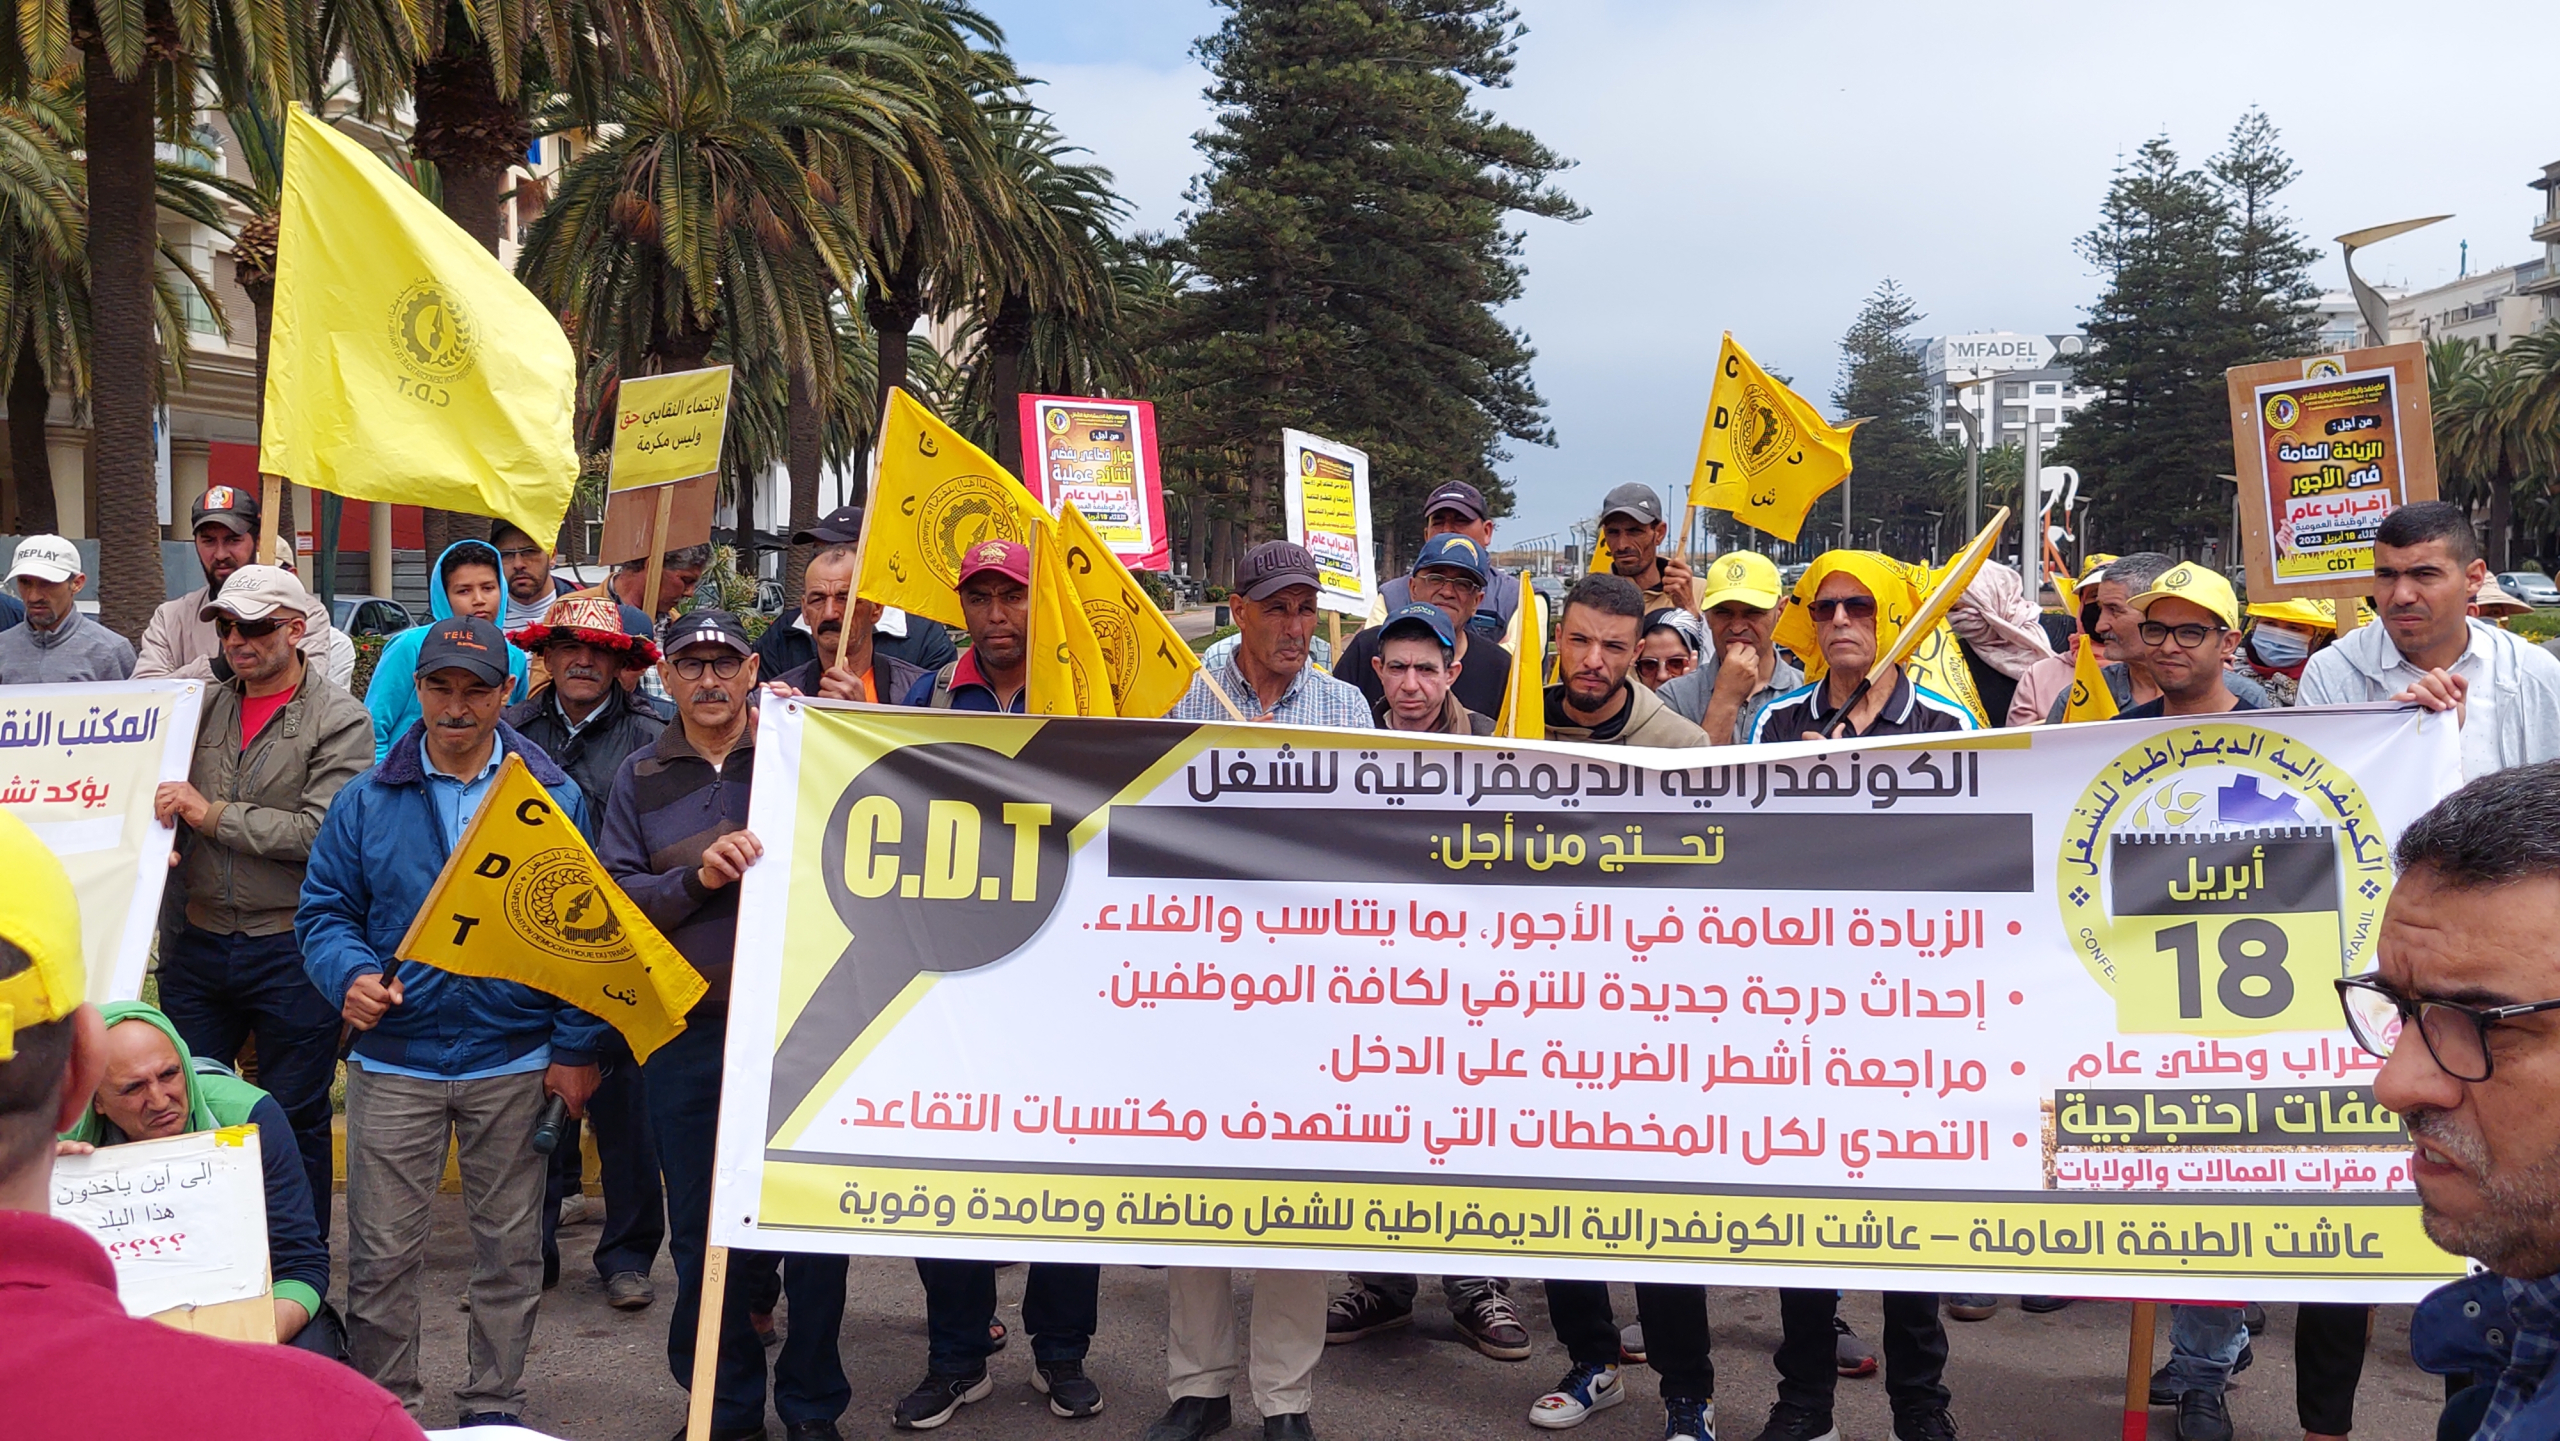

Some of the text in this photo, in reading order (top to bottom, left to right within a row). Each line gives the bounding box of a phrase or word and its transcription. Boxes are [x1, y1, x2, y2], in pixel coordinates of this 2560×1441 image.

[1958, 342, 2038, 357] MFADEL
[620, 410, 640, 430] حق
[642, 399, 684, 428] النقابي
[2359, 418, 2373, 428] من
[637, 425, 702, 454] وليس مكرمة
[2279, 442, 2382, 461] الزيادة العامة
[1079, 449, 1111, 461] قطاعي
[1112, 446, 1134, 465] حوار
[1052, 464, 1132, 486] لنتائج عملية
[2292, 464, 2380, 495] في الأجور
[1063, 489, 1129, 508] إضراب عام
[2291, 494, 2388, 523] إضراب عام
[2296, 520, 2332, 532] العمومية
[2334, 516, 2367, 527] الوظيفة
[2344, 532, 2356, 541] 18
[2298, 535, 2322, 545] 2023
[2323, 531, 2344, 545] أبريل
[18, 549, 60, 563] REPLAY
[1254, 547, 1310, 576] POLICE
[2327, 558, 2356, 571] CDT
[1328, 577, 1341, 588] CDT
[443, 631, 474, 640] TELE
[0, 706, 160, 758] المكتب النق
[1187, 743, 1978, 809] الكونفدرالية الديمقراطية للشغل
[0, 775, 110, 809] يؤكد تش
[1430, 813, 1514, 870] أجل:
[2066, 779, 2122, 876] للشغل
[844, 794, 1052, 902] C.D.T
[1525, 824, 1587, 871] من
[2168, 845, 2265, 902] أبريل
[1083, 893, 1243, 943] والغلاء.
[1257, 898, 1396, 947] يتناسب
[1410, 900, 1467, 948] بما
[1700, 906, 1834, 948] العامة
[1848, 908, 1983, 958] الزيادة
[531, 932, 595, 959] DEMOCRATIQUE
[1626, 905, 1684, 963] في
[2079, 908, 2375, 985] CONFE RAVAIL
[2155, 917, 2294, 1019] 18
[1099, 961, 1987, 1031] إحداث درجة جديدة للترقي لكافة الموظفين.
[1319, 1033, 1987, 1099] مراجعة أشطر الضريبة على الدخل.
[2067, 1041, 2142, 1082] عام
[2156, 1040, 2268, 1081] وطني
[2060, 1092, 2259, 1144] احتجاجية
[840, 1090, 1989, 1179] التصدي لكل المخططات التي تستهدف مكتسبات التقاعد.
[56, 1161, 213, 1205] إلى أين يأخذون
[2057, 1160, 2169, 1189] والولايات
[2178, 1159, 2286, 1181] العمالات
[2295, 1159, 2376, 1189] مقرات
[98, 1202, 176, 1231] هذا البلد
[839, 1181, 2384, 1265] عاشت الطبقة العاملة عاشت الكونفدرالية الديمقراطية للشغل مناضلة وصامدة وقوية
